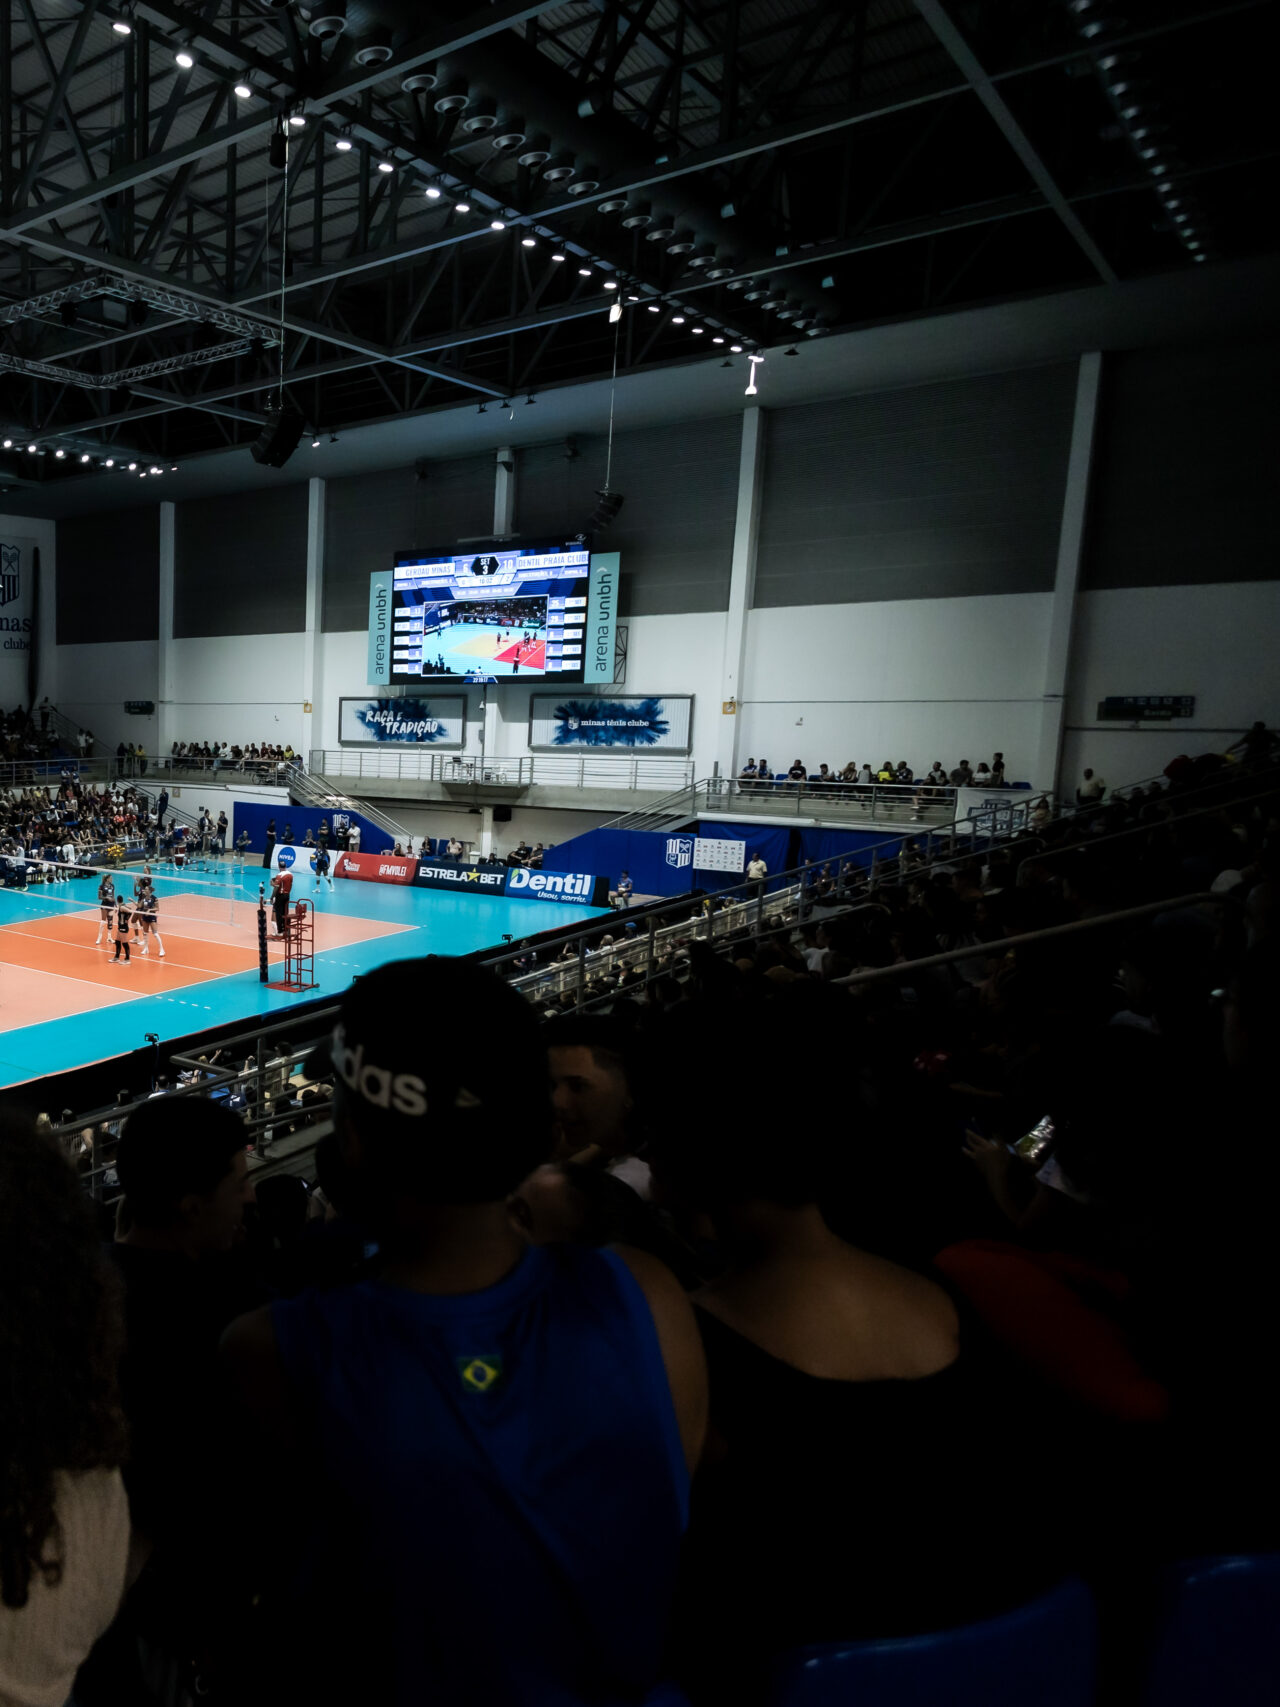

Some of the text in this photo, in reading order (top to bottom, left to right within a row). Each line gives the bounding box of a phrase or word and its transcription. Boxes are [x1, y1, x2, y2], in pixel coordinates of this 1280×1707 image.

[480, 558, 491, 566] SET
[503, 560, 514, 570] 10
[543, 556, 565, 565] PRAIA
[432, 565, 451, 575] MINAS
[482, 566, 489, 575] 3
[595, 573, 613, 672] arena unibh
[375, 589, 387, 675] arena unibh
[365, 710, 403, 726] RAÇA E
[581, 719, 650, 727] minas tênis clube
[385, 718, 438, 737] TRADIÇÃO
[279, 854, 294, 862] NIVEA
[418, 866, 505, 886] ESTRELA BET
[509, 868, 592, 895] Dentil
[537, 890, 587, 903] Usou, sorriu.
